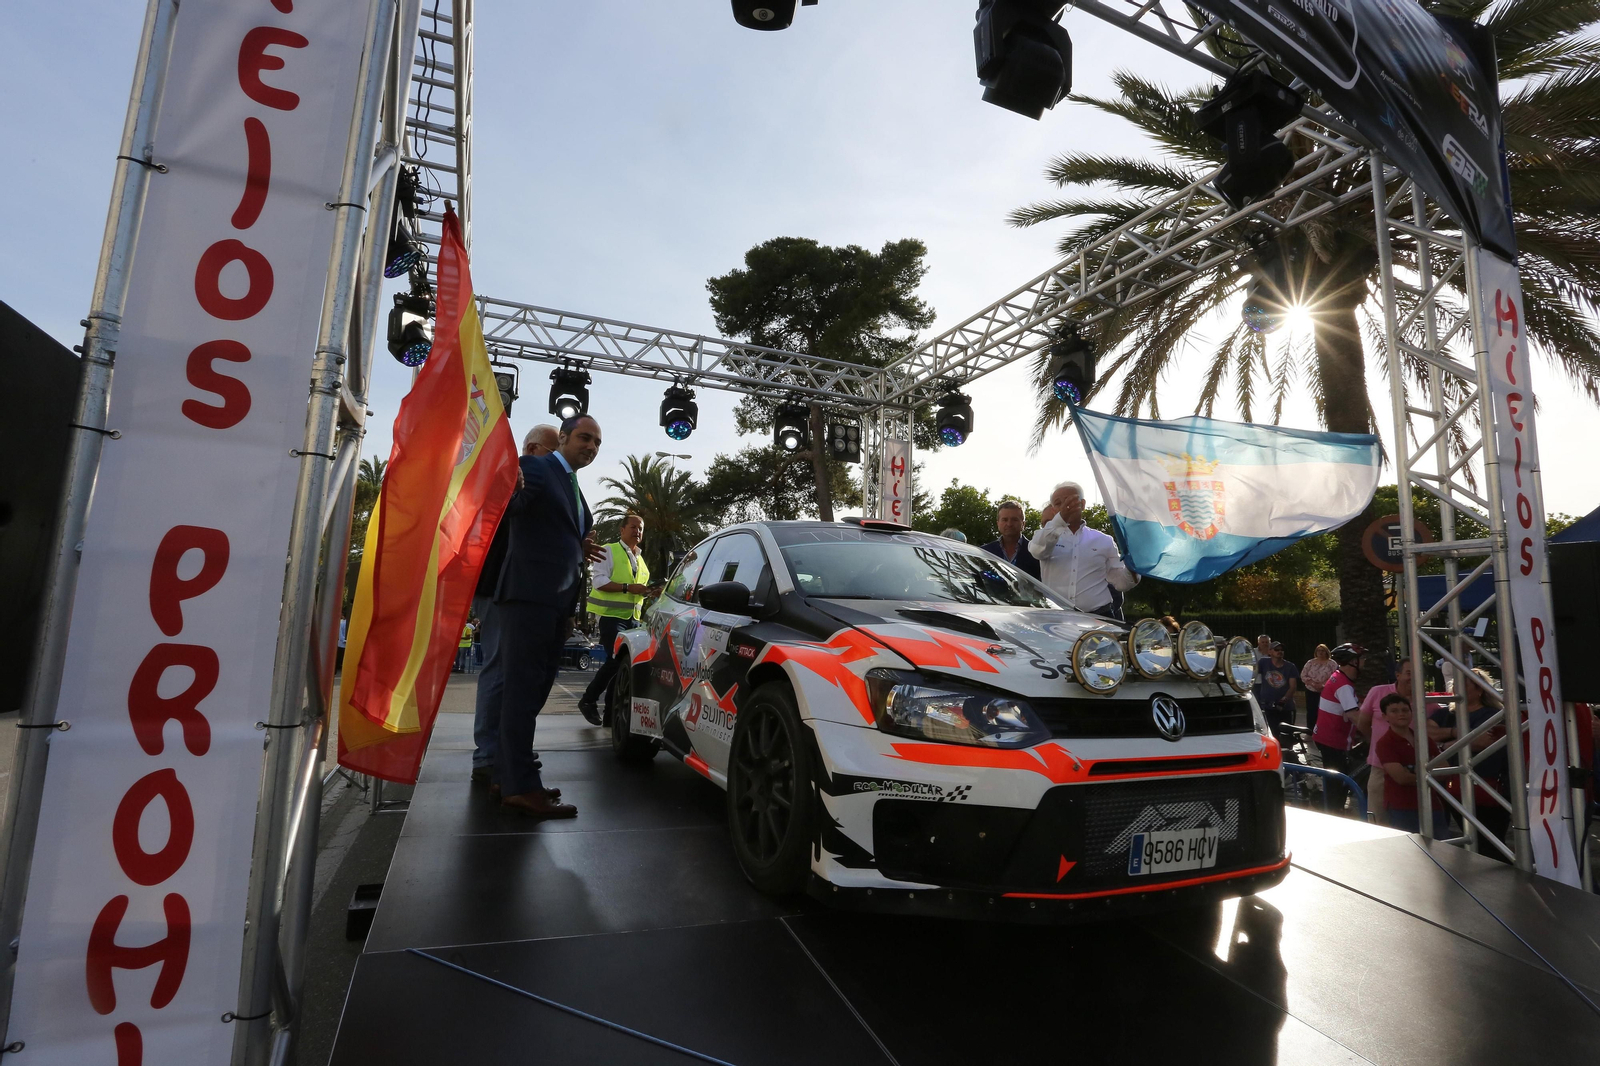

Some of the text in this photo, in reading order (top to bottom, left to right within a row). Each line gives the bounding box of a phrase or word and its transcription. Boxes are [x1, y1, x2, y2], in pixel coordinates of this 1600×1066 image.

[890, 456, 905, 523] HiE
[877, 791, 938, 801] motorsport
[1142, 835, 1217, 866] 9586 HCV
[1132, 857, 1140, 868] E
